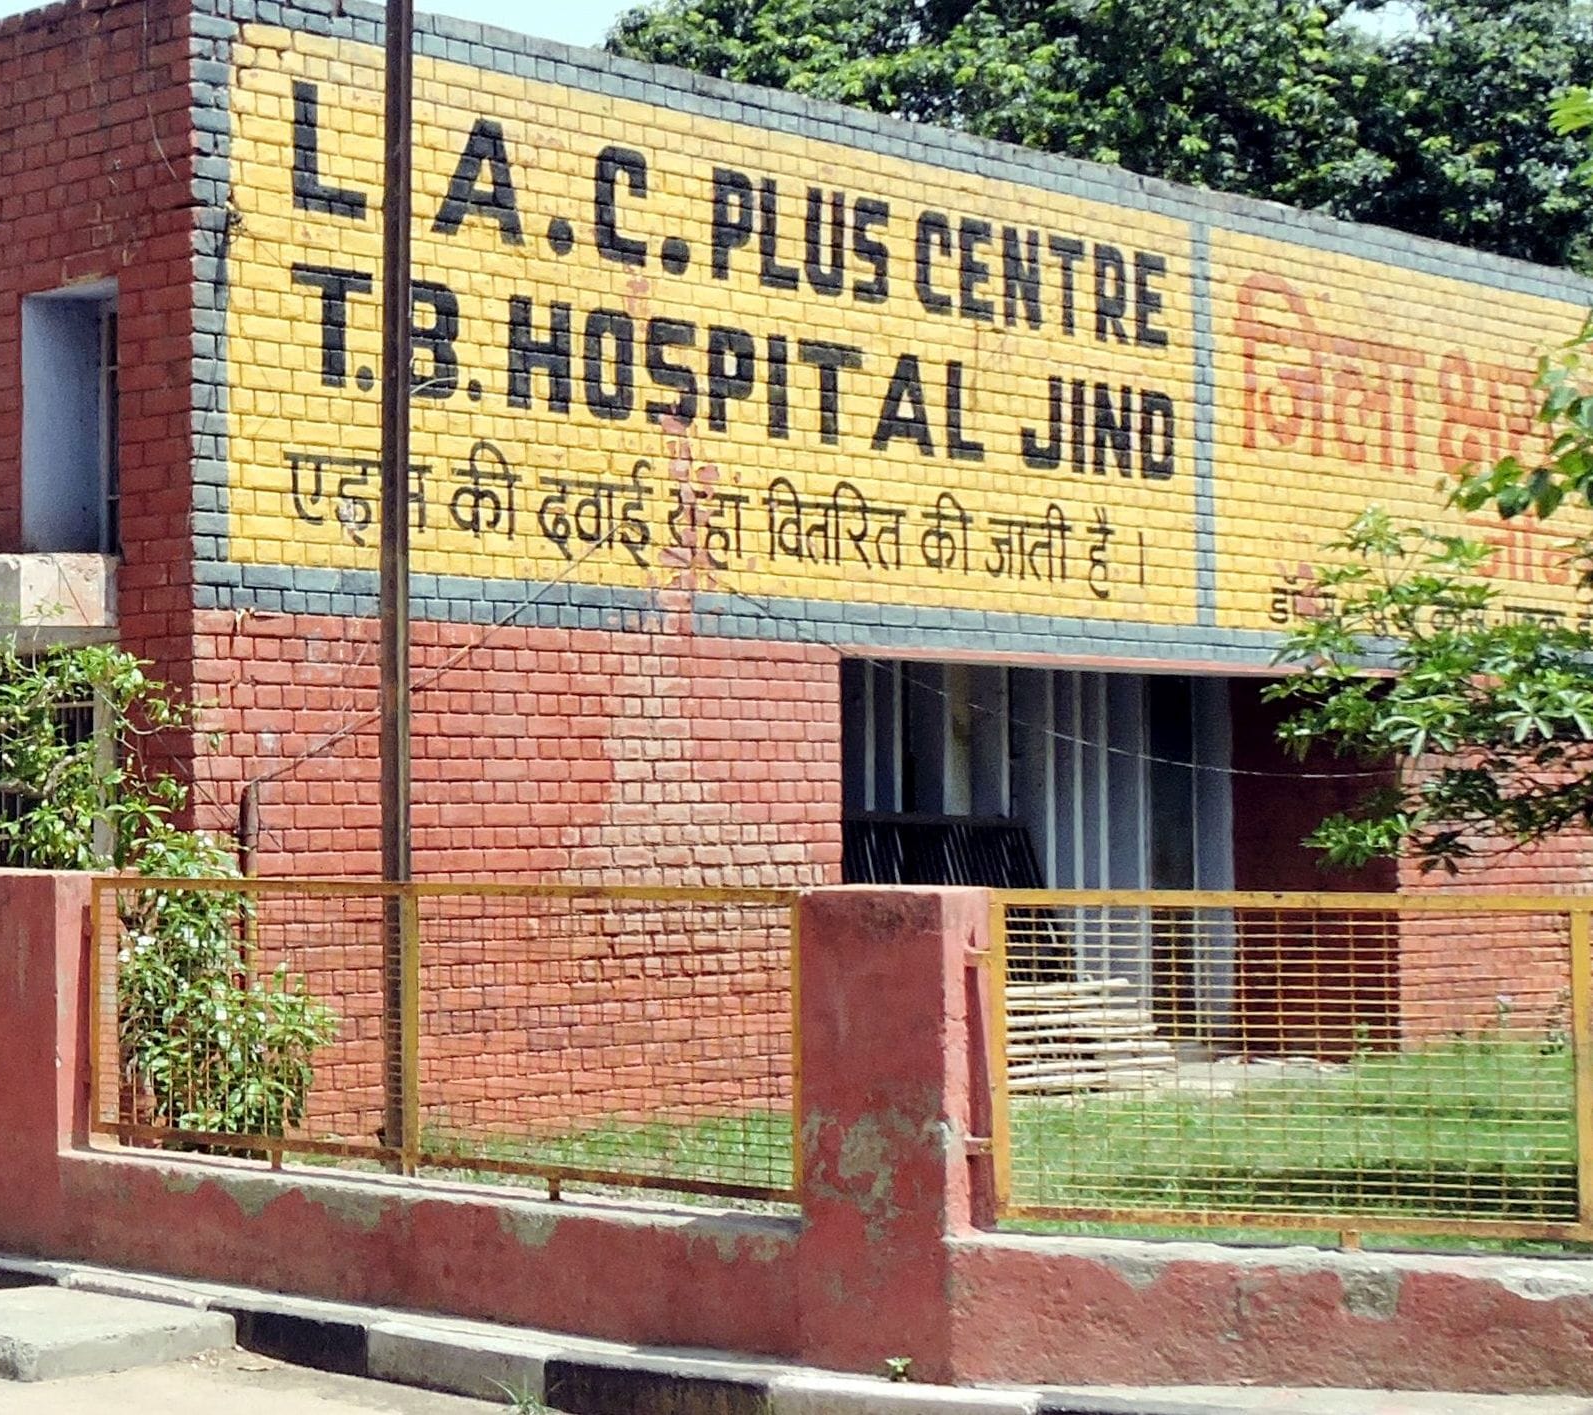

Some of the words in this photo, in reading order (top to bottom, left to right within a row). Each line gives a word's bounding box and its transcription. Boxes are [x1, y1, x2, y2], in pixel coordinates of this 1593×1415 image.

[291, 79, 690, 276] LA.C.
[710, 166, 889, 303] PLUS
[914, 210, 1169, 347] CENTRE
[290, 261, 483, 402] T.B.
[507, 294, 985, 462] HOSPITAL
[1020, 375, 1175, 481] JIND
[449, 439, 522, 541] की
[537, 459, 654, 569] दवाई
[762, 475, 907, 572] वितरित
[920, 490, 974, 576] की
[984, 502, 1073, 583] जाती
[1086, 505, 1115, 600] है
